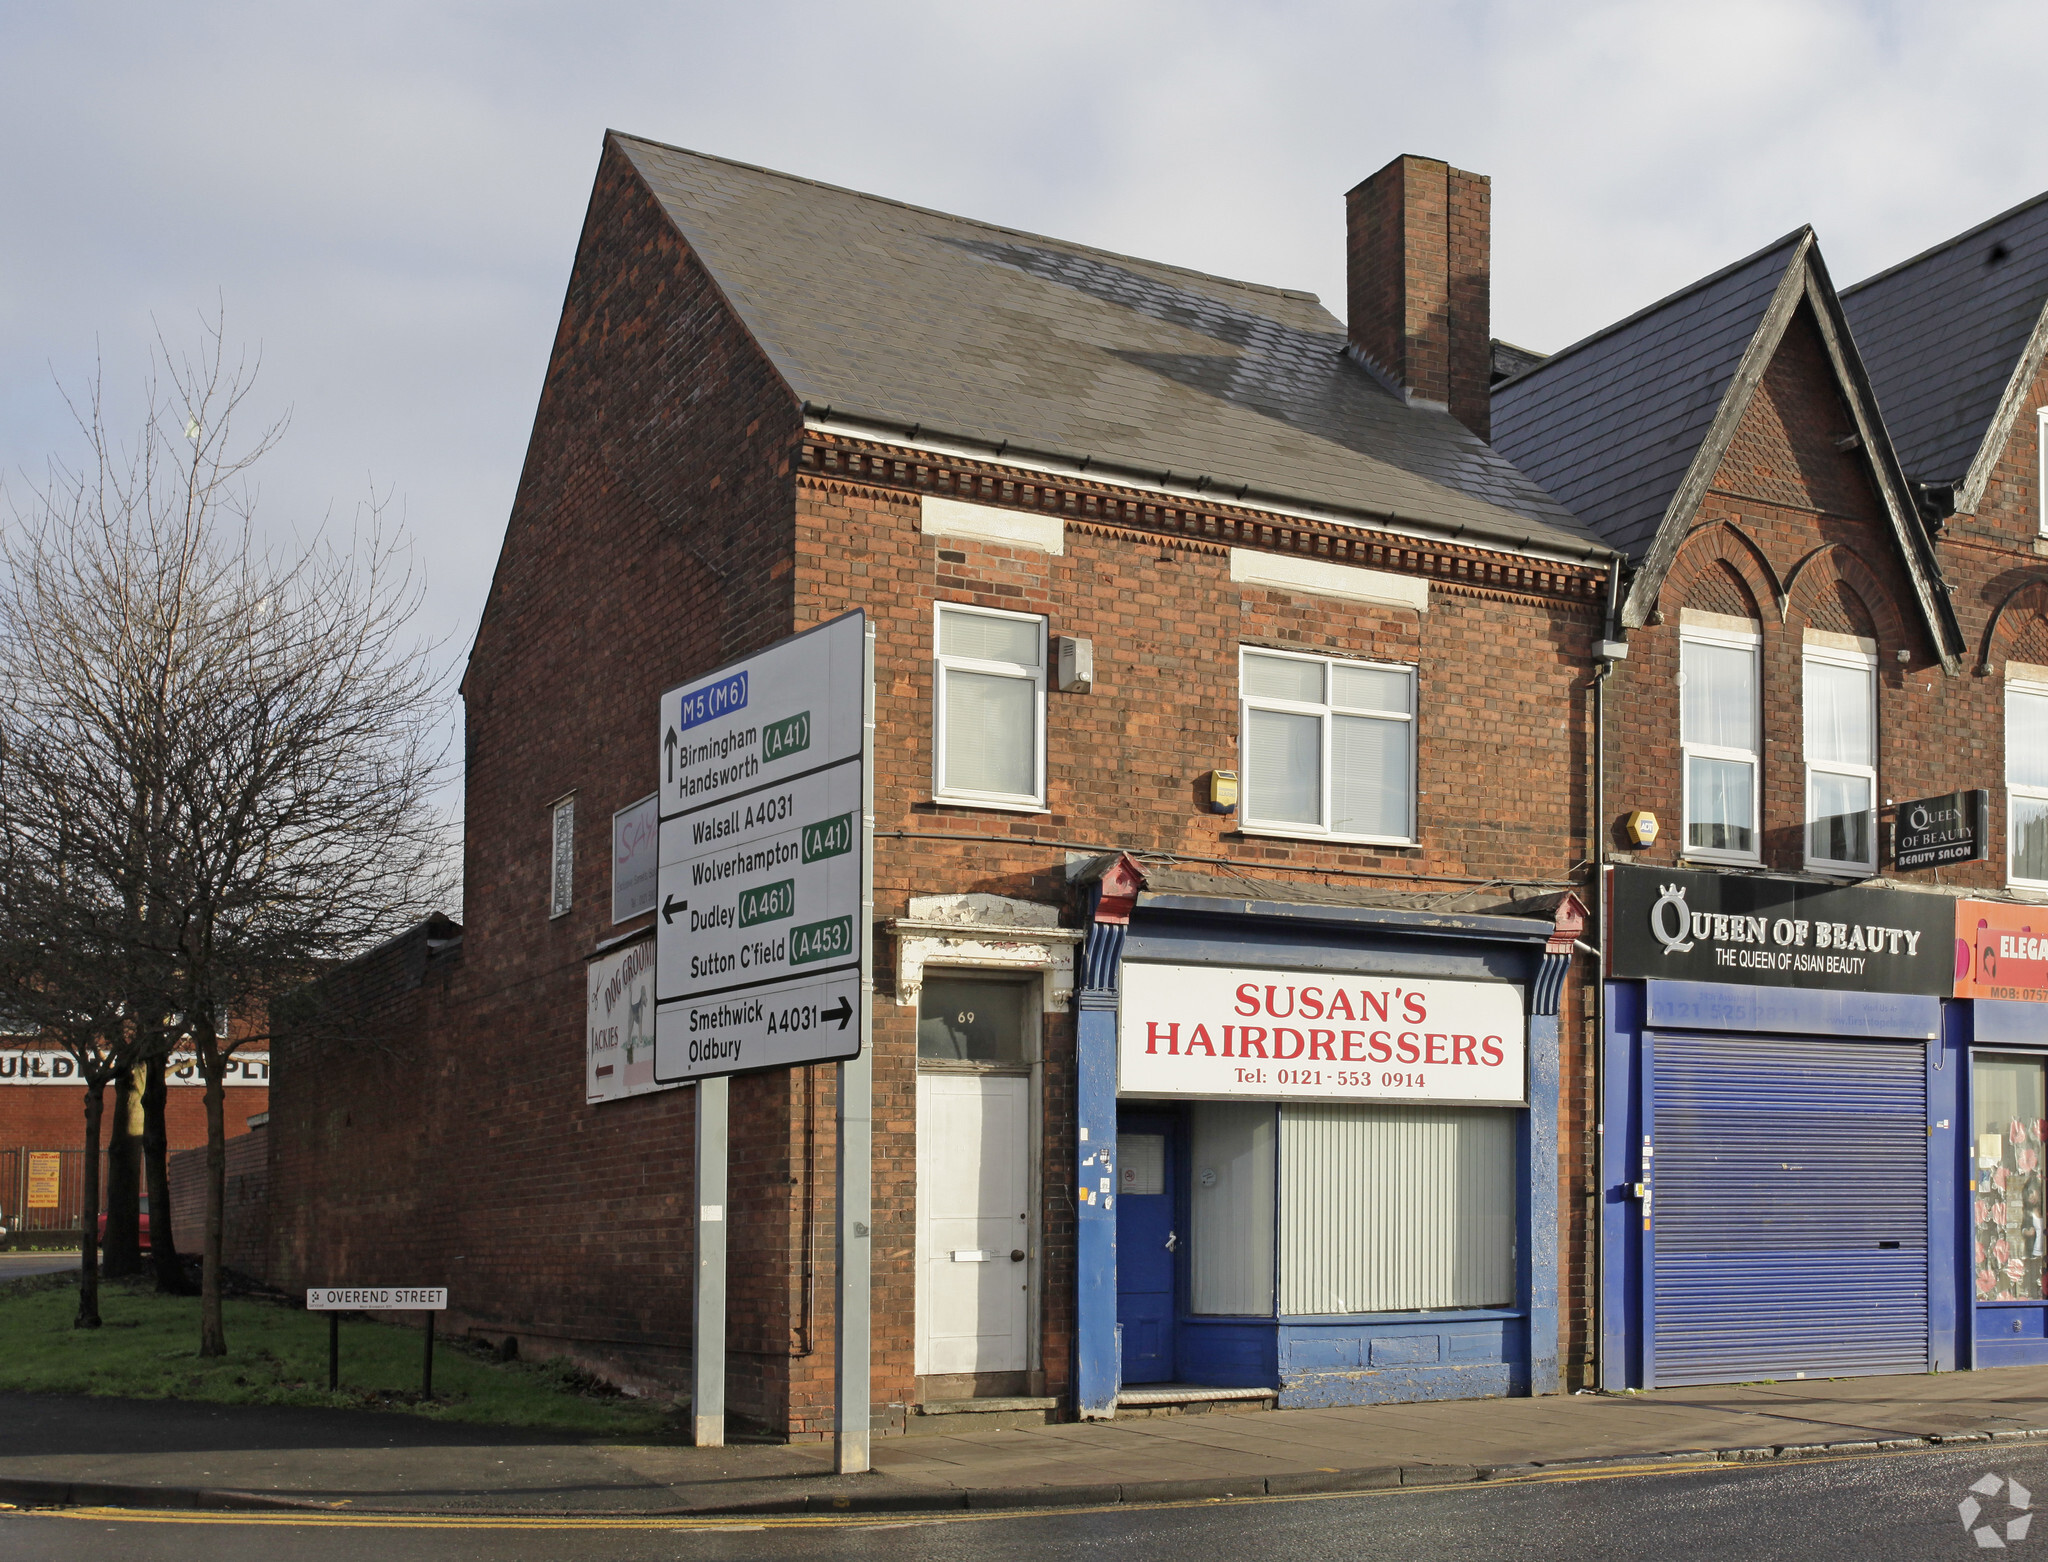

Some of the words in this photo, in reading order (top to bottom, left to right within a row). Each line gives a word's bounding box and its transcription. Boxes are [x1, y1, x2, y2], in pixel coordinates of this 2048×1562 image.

[680, 727, 757, 769] Birmingham
[765, 716, 808, 758] (A41)
[679, 753, 759, 799] Handsworth
[692, 810, 740, 845] Walsall
[744, 793, 793, 830] A4031
[1902, 835, 1919, 848] OF
[1923, 826, 1974, 845] BEAUTY
[692, 842, 799, 886] Wolverhampton
[804, 818, 850, 859] (A41)
[1899, 852, 1935, 866] BEAUTY
[1938, 846, 1971, 860] SALON
[691, 905, 735, 932] Dudley
[741, 883, 793, 923] (A461)
[690, 952, 735, 979] Sutton
[740, 937, 785, 968] C'field
[792, 920, 850, 960] (A453)
[1773, 918, 1809, 947] OF
[1815, 921, 1921, 956] BEAUTY
[1716, 948, 1737, 966] THE
[1739, 950, 1775, 969] QUEEN
[1777, 953, 1792, 970] OF
[1793, 954, 1824, 972] ASIAN
[1826, 956, 1866, 975] BEAUTY
[604, 967, 622, 1013] DOG
[1234, 983, 1427, 1025] SUSAN'S
[1990, 987, 2020, 999] MOB:
[689, 999, 763, 1032] Smethwick
[767, 1005, 817, 1035] A4031
[957, 1011, 975, 1024] 69
[591, 1026, 619, 1058] JACKIES
[689, 1038, 742, 1063] Oldbury
[1145, 1021, 1504, 1067] HAIRDRESSERS
[1234, 1068, 1266, 1084] Tel:
[1381, 1072, 1426, 1088] 0914
[327, 1291, 389, 1303] OVEREND
[395, 1290, 443, 1303] STREET
